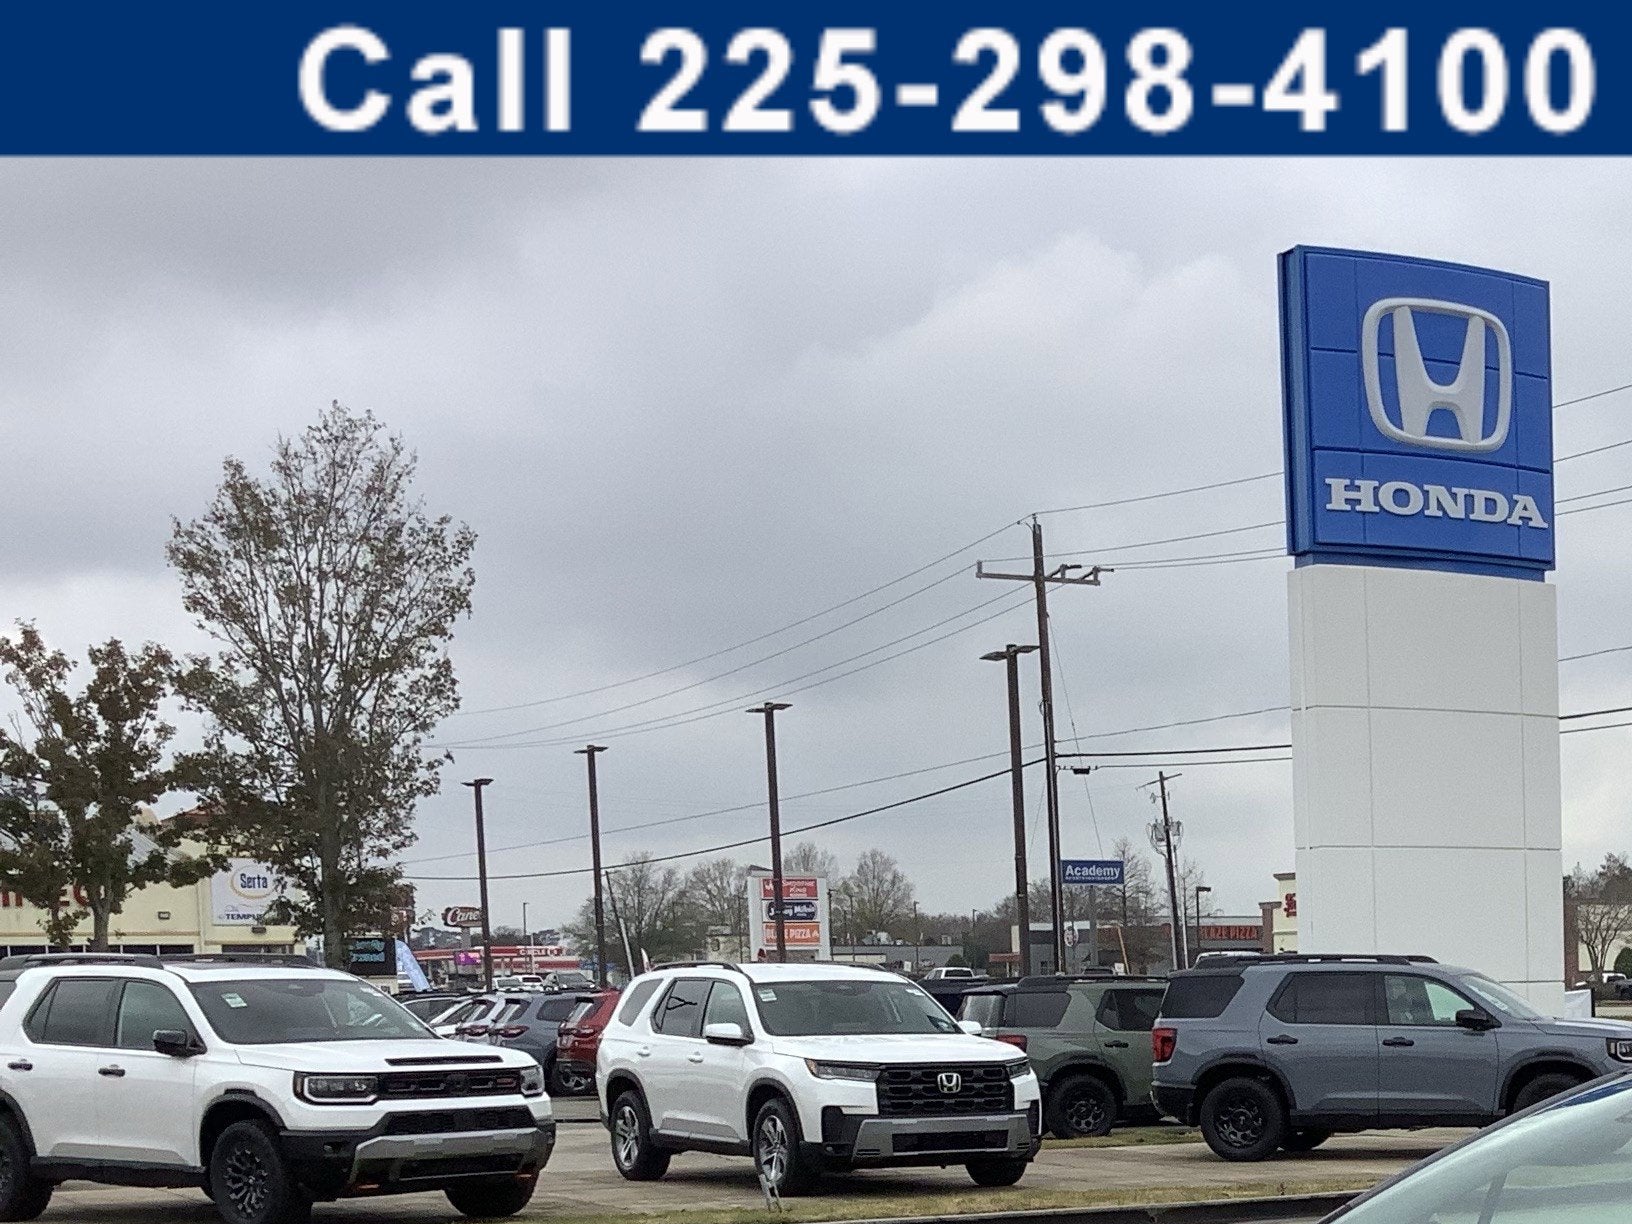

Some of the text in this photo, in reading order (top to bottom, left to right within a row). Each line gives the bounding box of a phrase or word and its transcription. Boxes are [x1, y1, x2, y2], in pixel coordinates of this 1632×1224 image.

[1325, 478, 1548, 528] HONDA
[1065, 865, 1120, 879] Academy
[240, 873, 268, 889] Serta
[446, 907, 482, 926] Cane
